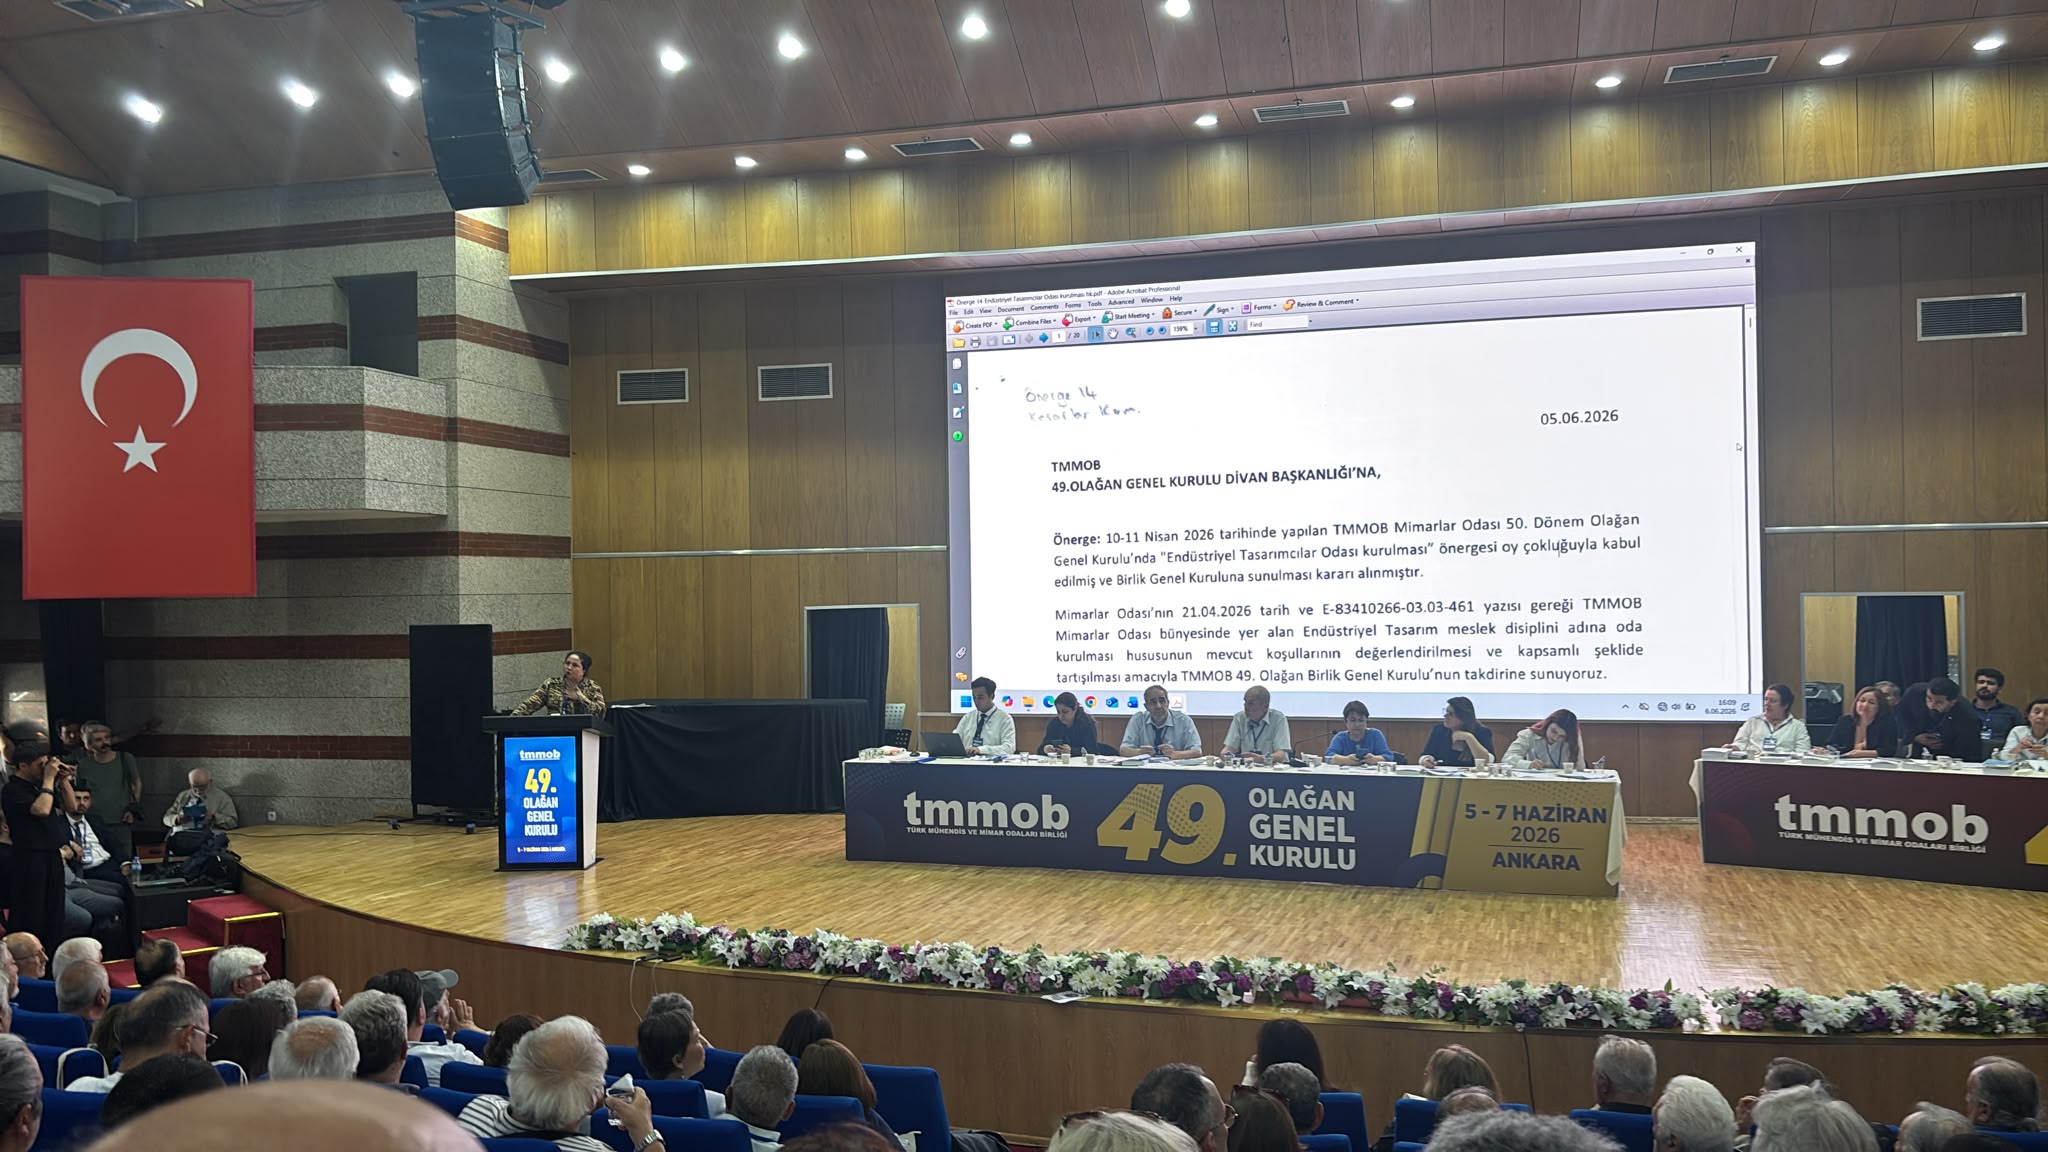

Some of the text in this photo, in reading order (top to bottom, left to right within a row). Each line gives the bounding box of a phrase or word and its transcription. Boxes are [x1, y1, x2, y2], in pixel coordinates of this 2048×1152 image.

[998, 305, 1024, 313] Document
[1031, 303, 1059, 311] Comments
[1141, 296, 1163, 304] Window
[1075, 315, 1091, 323] Export
[1131, 312, 1150, 320] Meeting
[1217, 306, 1229, 314] Sign
[1254, 303, 1271, 311] Forms
[1325, 298, 1354, 306] Comment
[1079, 386, 1097, 400] 14
[1541, 410, 1618, 425] 05.06.2026
[1051, 460, 1100, 472] TMMOB
[1052, 477, 1121, 492] 49.OLAĞAN
[1126, 478, 1166, 489] GENEL
[1170, 474, 1221, 487] KURULU
[1226, 471, 1267, 484] DİVAN
[1054, 514, 1639, 546] Önerge: 10-11 Nisan 2026 tarihinde yapılan TMMOB Mimarlar Odası 50. Dönem Olağan
[1054, 554, 1087, 566] Genel
[1240, 547, 1317, 560] Tasarımcılar
[1321, 546, 1358, 558] Odası
[1440, 541, 1497, 556] önergesi
[1502, 544, 1518, 555] oy
[1524, 538, 1597, 554] çokluğuyla
[1603, 536, 1640, 549] kabul
[1055, 567, 1423, 588] edilmiş ve Birlik Genel Kuruluna sunulması kararı alınmıştır.
[1056, 609, 1109, 620] Mimarlar
[1183, 605, 1251, 617] 21.04.2026
[1260, 604, 1289, 616] tarih
[1299, 607, 1313, 615] ve
[1323, 601, 1474, 614] E-83410266-03.03-461
[1484, 603, 1520, 614] yazısı
[1531, 599, 1573, 614] gereği
[1583, 598, 1641, 609] TMMOB
[1056, 620, 1642, 641] Mimarlar Odası bünyesinde yer alan Endüstriyel Tasarım meslek disiplini adına oda
[1057, 644, 1643, 662] kurulması hususunun mevcut koşullarının değerlendirilmesi ve kapsamlı şeklide
[1057, 672, 1120, 685] tartışılması
[1125, 671, 1177, 684] amacıyla
[1181, 671, 1232, 681] TMMOB
[1236, 670, 1255, 681] 49.
[1260, 670, 1303, 684] Olağan
[1308, 669, 1340, 681] Birlik
[1345, 669, 1382, 681] Genel
[1465, 668, 1525, 680] takdirine
[1531, 670, 1607, 682] sunuyoruz.
[520, 749, 560, 760] tmmob
[525, 768, 556, 793] 49.
[523, 794, 558, 808] OLAĞAN
[1248, 785, 1355, 811] OLAĞAN
[527, 811, 555, 822] GENEL
[904, 791, 1069, 830] tmmob
[1465, 804, 1476, 819] 5
[1496, 805, 1506, 820] 7
[1513, 801, 1607, 824] HAZİRAN
[1774, 794, 1989, 844] tmmob
[524, 824, 558, 836] KURULU
[1096, 783, 1237, 866] 49.
[1249, 813, 1355, 843] GENEL
[1511, 826, 1560, 844] 2026
[1778, 831, 1803, 839] TÜRK
[1805, 834, 1853, 843] MÜHENDİS
[1870, 838, 1902, 847] MİMAR
[1904, 841, 1947, 850] ODALARI
[1949, 844, 1986, 853] BİRLİĞİ
[1249, 845, 1356, 871] KURULU
[1492, 852, 1581, 871] ANKARA
